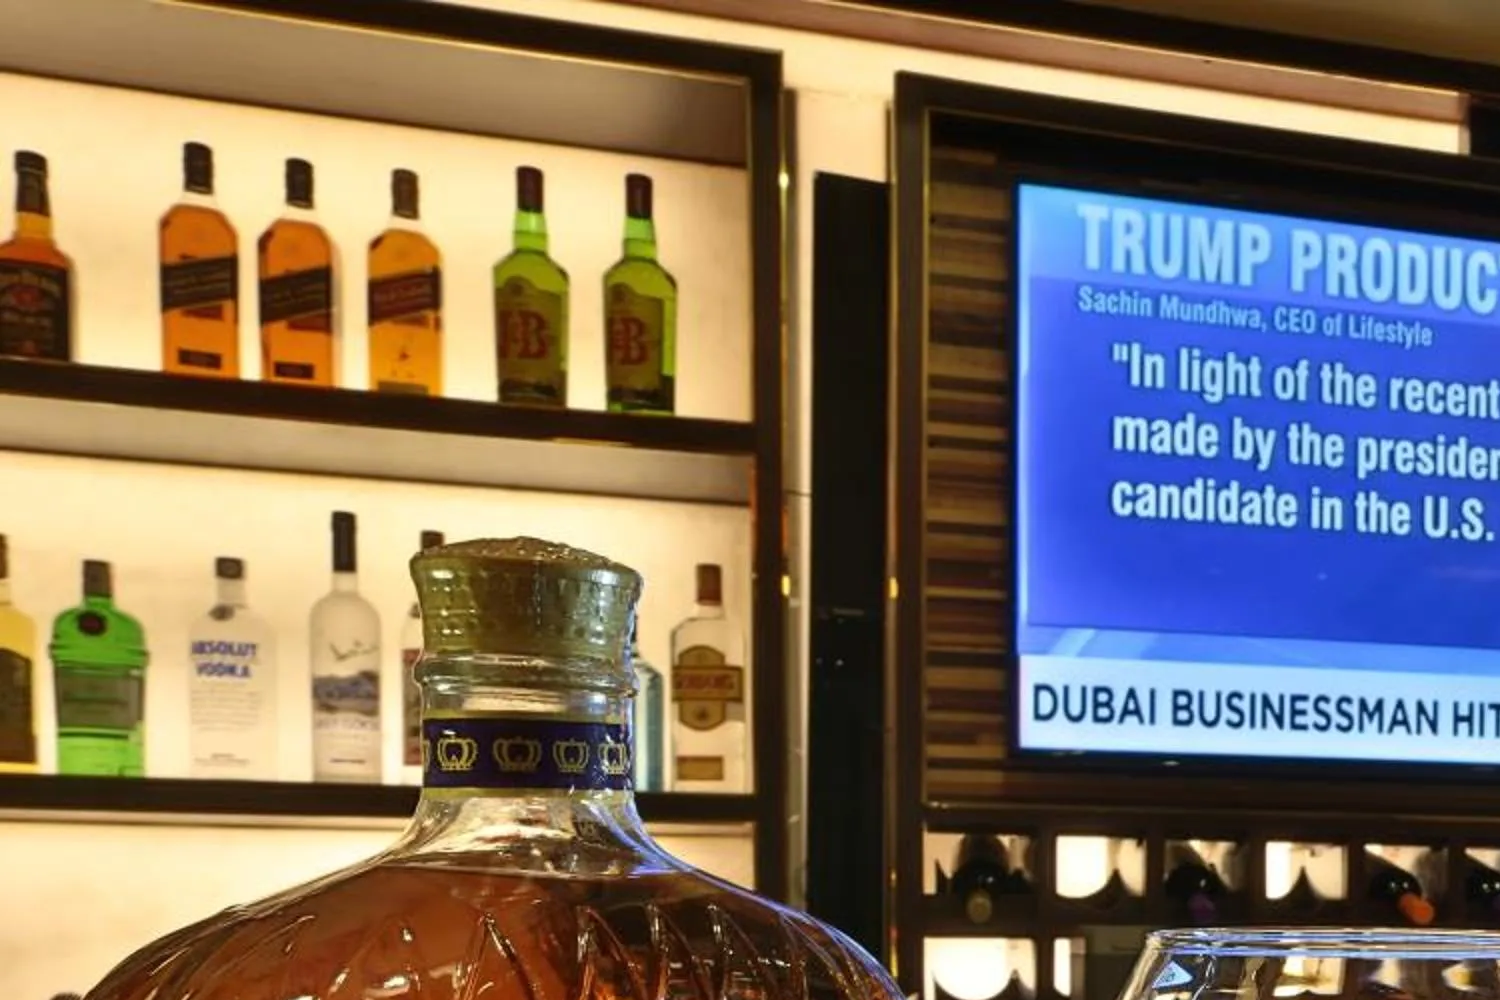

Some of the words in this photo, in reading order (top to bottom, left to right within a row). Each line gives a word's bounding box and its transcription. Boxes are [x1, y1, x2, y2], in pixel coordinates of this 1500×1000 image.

[1077, 202, 1271, 286] TRUMP
[1078, 285, 1152, 317] Sachin
[1159, 294, 1267, 332] Mundhwa,
[1274, 305, 1316, 334] CEO
[1322, 313, 1344, 336] of
[1349, 316, 1434, 349] Lifestyle
[1113, 342, 1165, 388] "In
[1179, 347, 1261, 403] light
[1274, 359, 1309, 401] of
[1320, 363, 1376, 407] the
[1390, 377, 1500, 419] recent
[1113, 412, 1219, 458] made
[1233, 416, 1276, 471] by
[1287, 422, 1344, 468] the
[1112, 477, 1298, 527] candidate
[1311, 486, 1343, 530] in
[1356, 490, 1411, 535] the
[1423, 495, 1495, 541] U.S.
[191, 640, 257, 657] ABSOLUT
[196, 662, 250, 678] VODKA
[1033, 683, 1156, 725] DUBAI
[1171, 688, 1439, 735] BUSINESSMAN
